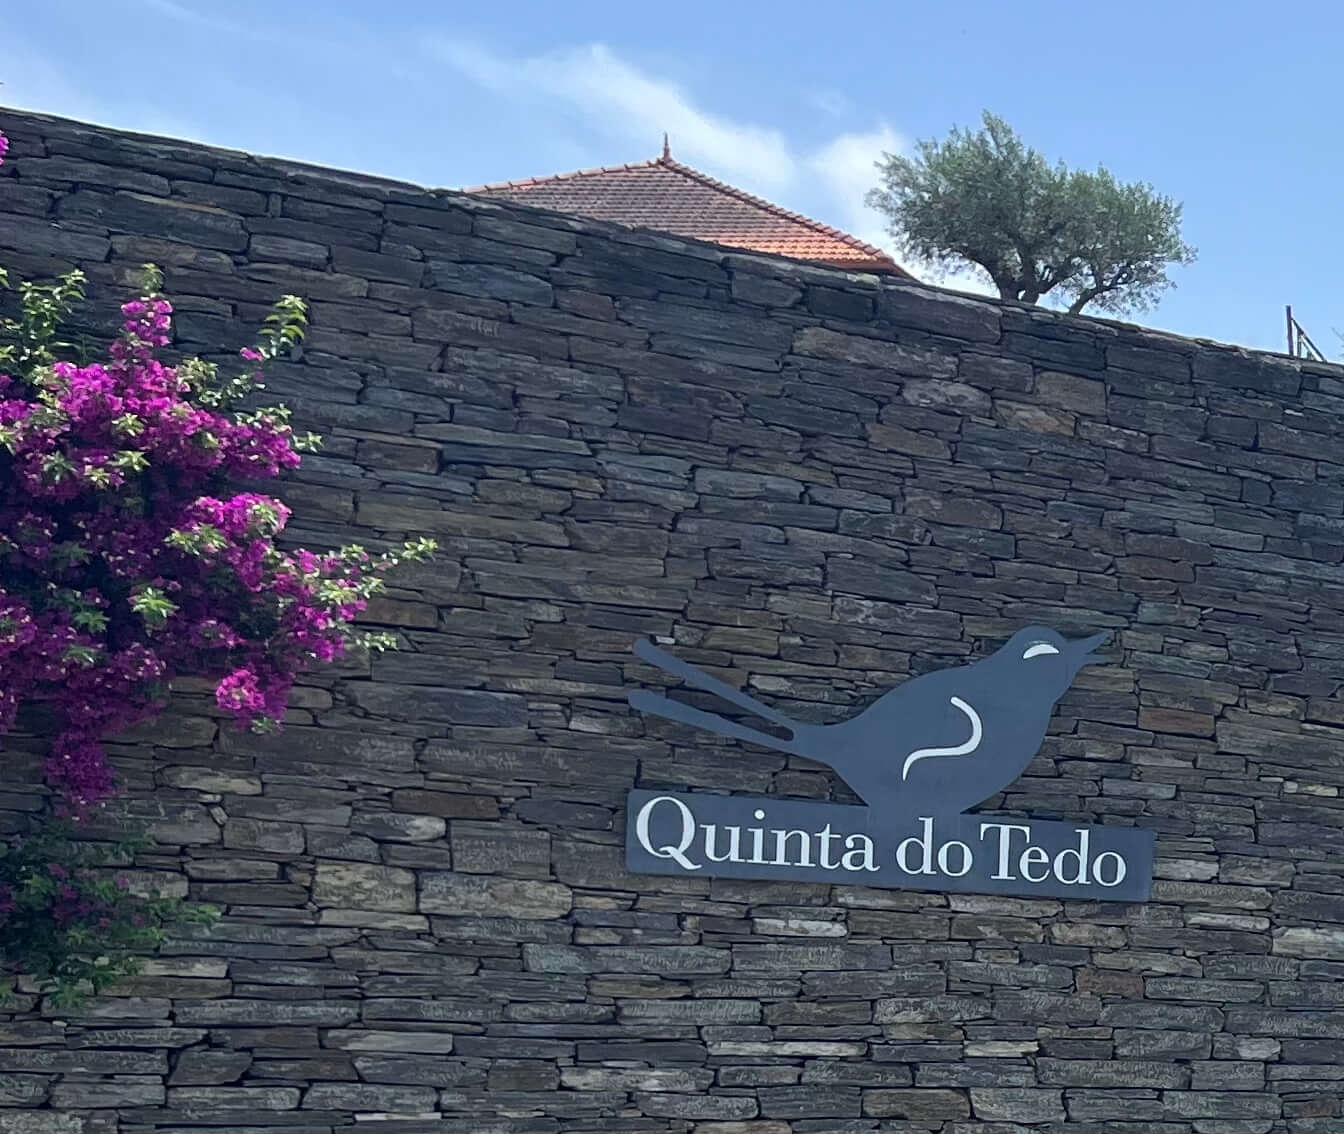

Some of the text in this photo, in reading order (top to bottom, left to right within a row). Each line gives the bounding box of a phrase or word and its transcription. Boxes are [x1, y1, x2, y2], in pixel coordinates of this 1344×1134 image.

[635, 796, 1127, 886] Quinta do Tedo
